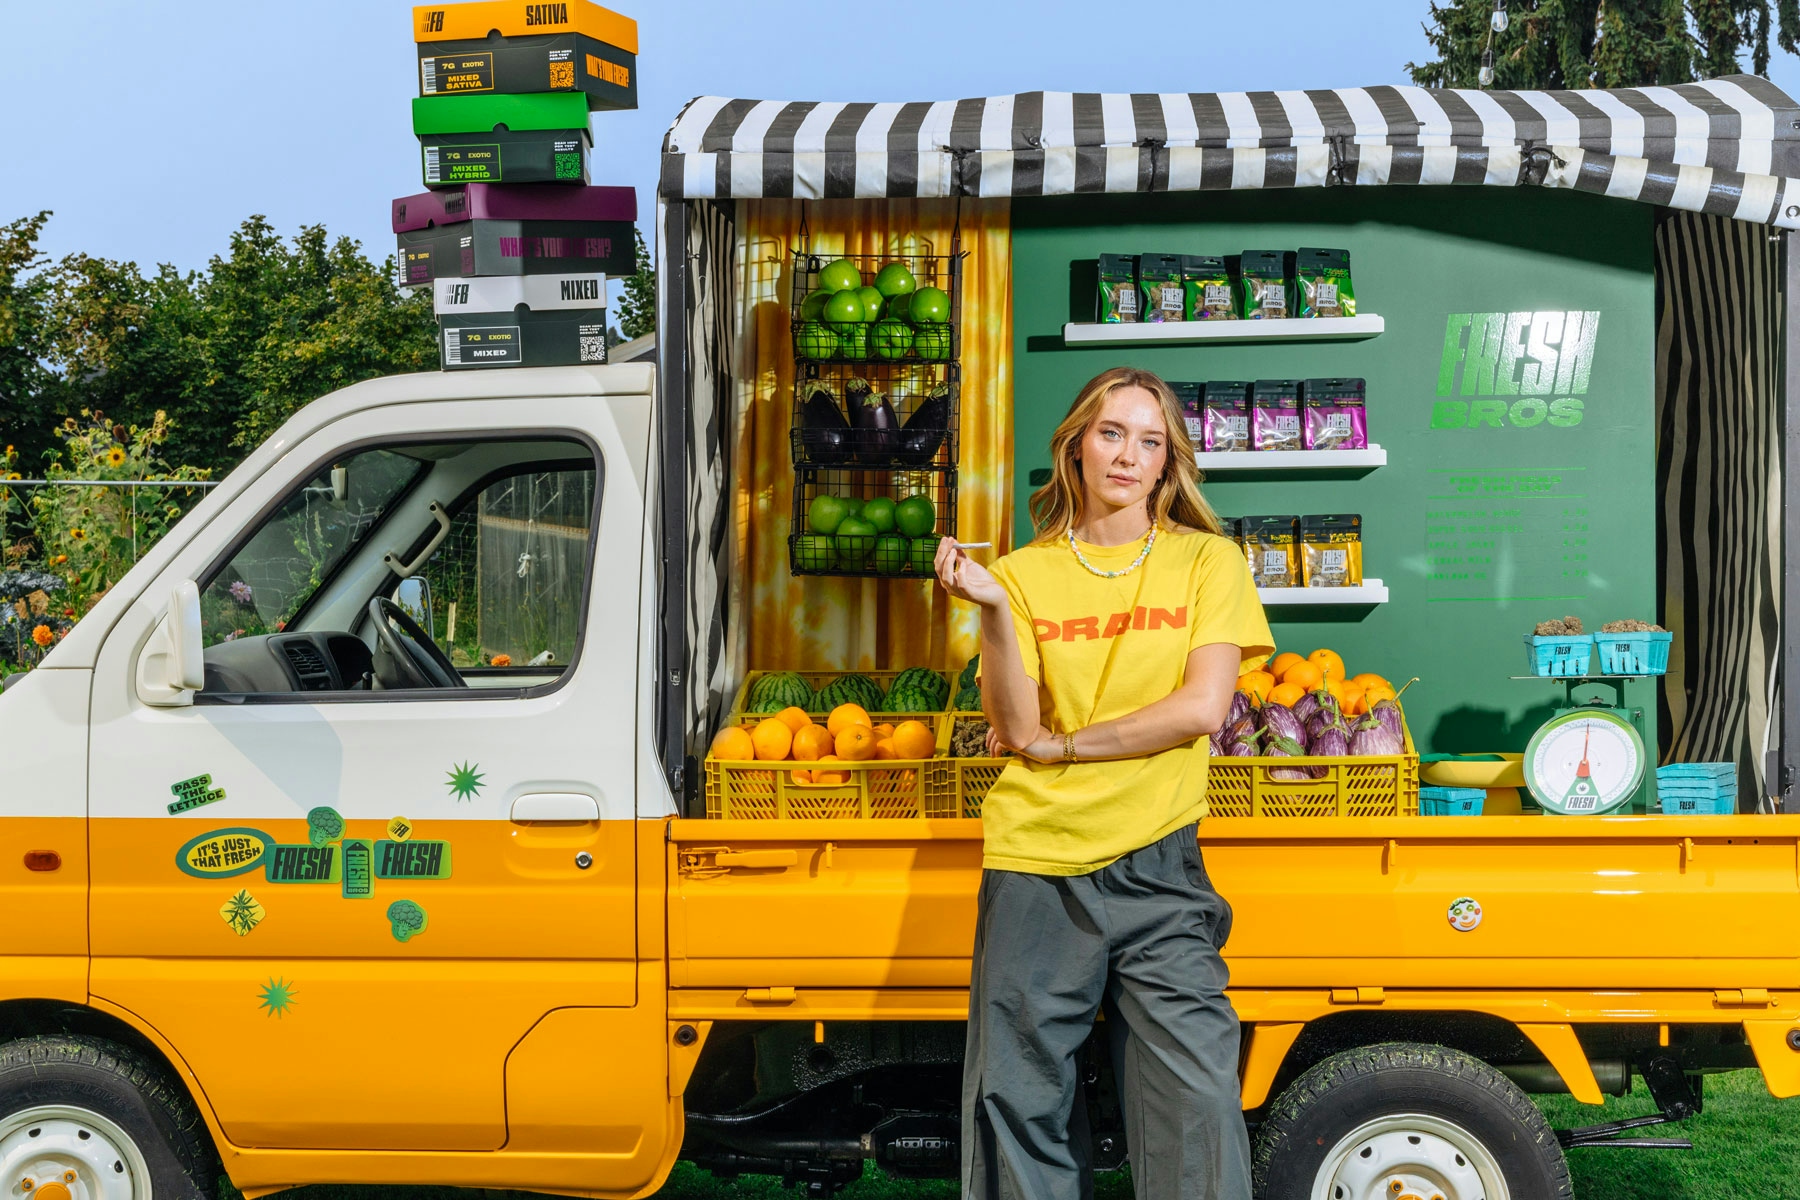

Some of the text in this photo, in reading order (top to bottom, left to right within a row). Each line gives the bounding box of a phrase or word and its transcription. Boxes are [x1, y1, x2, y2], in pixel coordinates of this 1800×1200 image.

[428, 3, 568, 32] FB SATIVA
[446, 81, 482, 89] SATIVA
[448, 74, 479, 82] MIXED
[449, 171, 491, 179] HYBRID
[452, 164, 487, 172] MIXED
[453, 279, 599, 305] FB MIXED
[1205, 285, 1231, 298] FRESH
[1316, 284, 1338, 297] FRESH
[473, 349, 507, 357] MIXED
[1436, 311, 1601, 396] FRESH
[1327, 414, 1351, 428] FRESH
[1430, 398, 1585, 430] BROS
[1276, 416, 1300, 430] FRESH
[1554, 646, 1571, 655] FRESH
[1615, 643, 1630, 653] FRESH
[174, 776, 207, 793] PASS
[182, 786, 206, 799] THE
[169, 790, 223, 812] LETTUCE
[1567, 796, 1595, 809] FRESH
[1679, 800, 1696, 810] FRESH
[222, 838, 251, 852] JUST
[191, 847, 260, 868] THAT FRESH
[272, 847, 334, 880] FRESH
[381, 843, 443, 876] FRESH
[347, 850, 369, 888] FRESH
